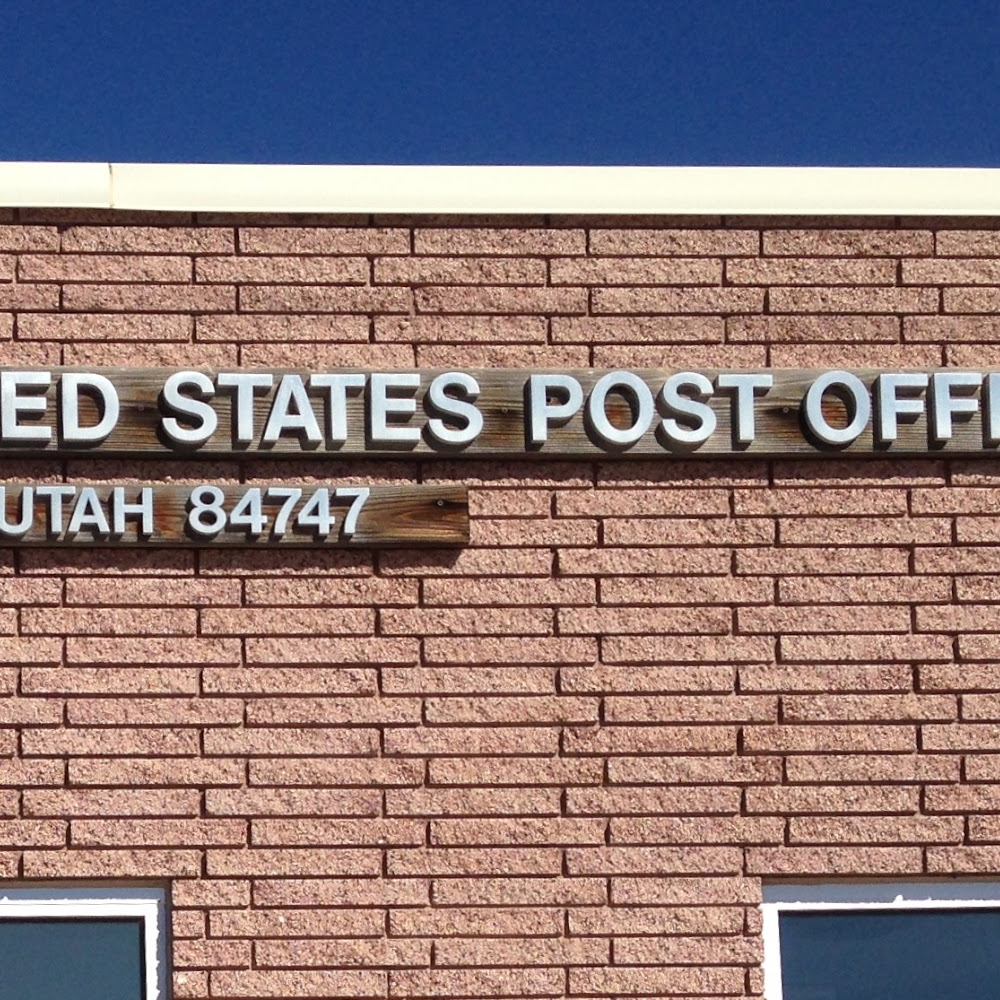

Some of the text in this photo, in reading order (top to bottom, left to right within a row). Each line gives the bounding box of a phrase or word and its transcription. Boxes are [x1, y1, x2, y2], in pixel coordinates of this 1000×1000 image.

[161, 371, 485, 445] STATES
[530, 371, 773, 444] POST
[188, 485, 371, 537] 84747
